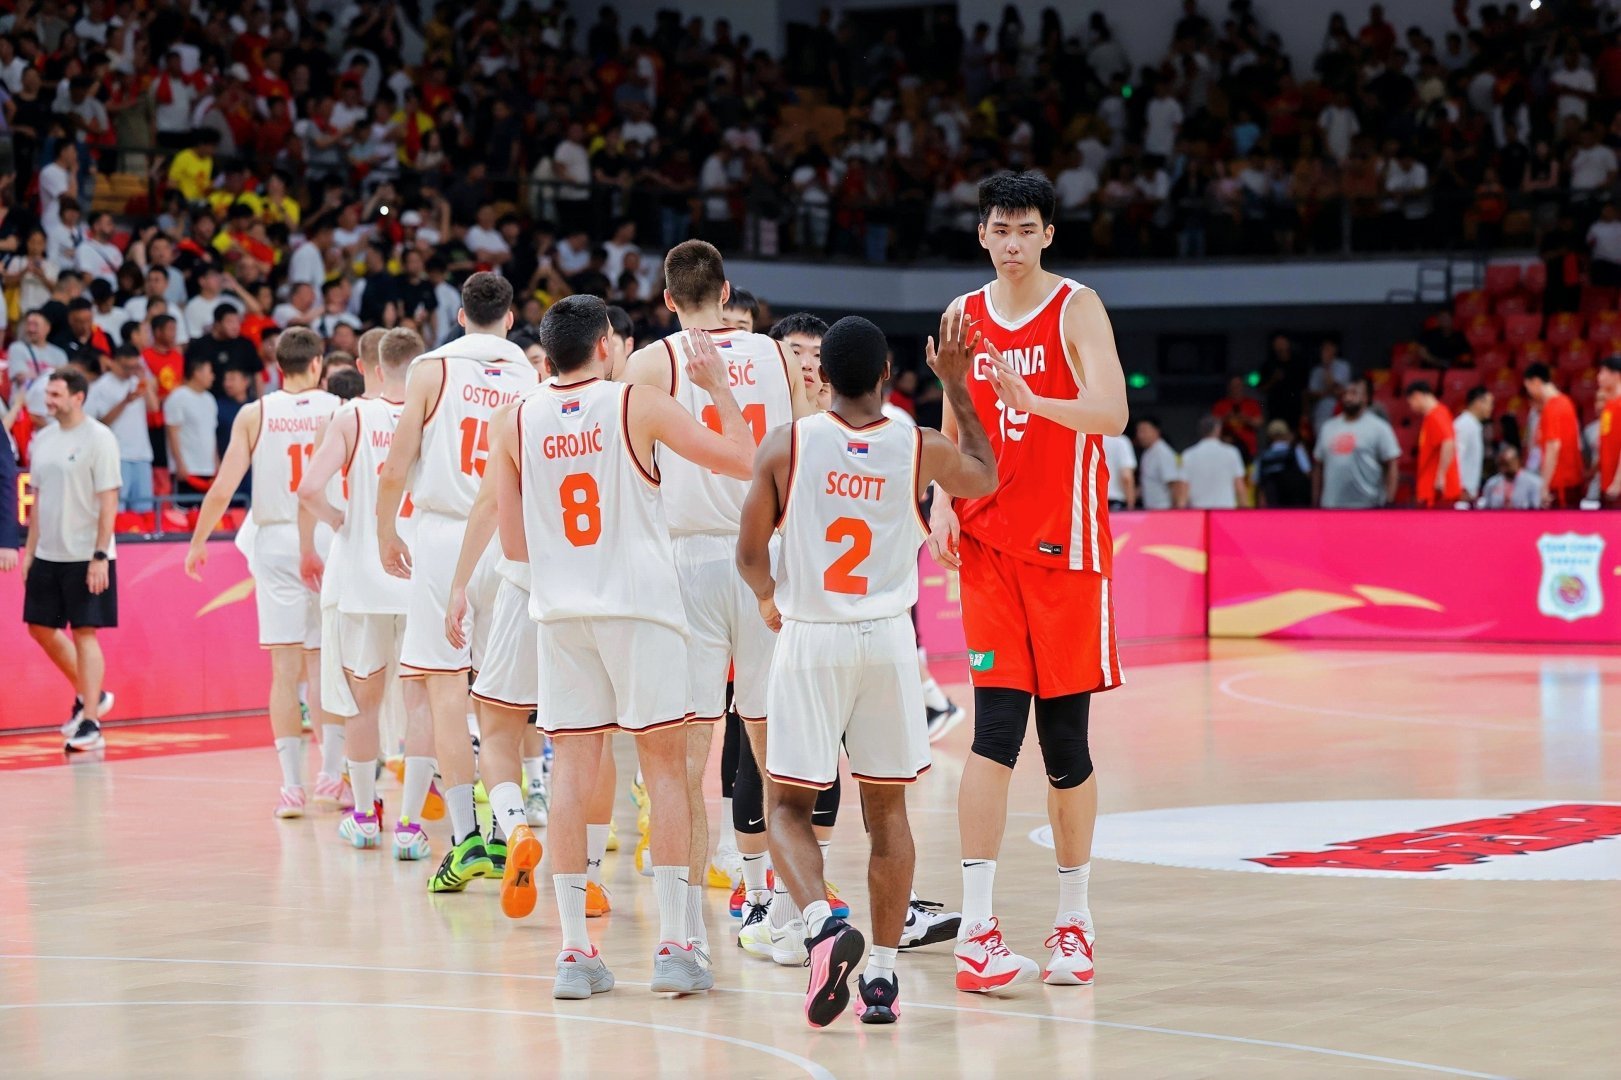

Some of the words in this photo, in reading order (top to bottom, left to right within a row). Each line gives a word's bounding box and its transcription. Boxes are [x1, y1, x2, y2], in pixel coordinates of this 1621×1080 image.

[973, 344, 1046, 381] CINA
[372, 430, 395, 448] MA
[543, 422, 603, 460] GROJIĆ
[825, 470, 886, 501] SCOTT
[559, 472, 602, 548] 8
[823, 516, 873, 596] 2
